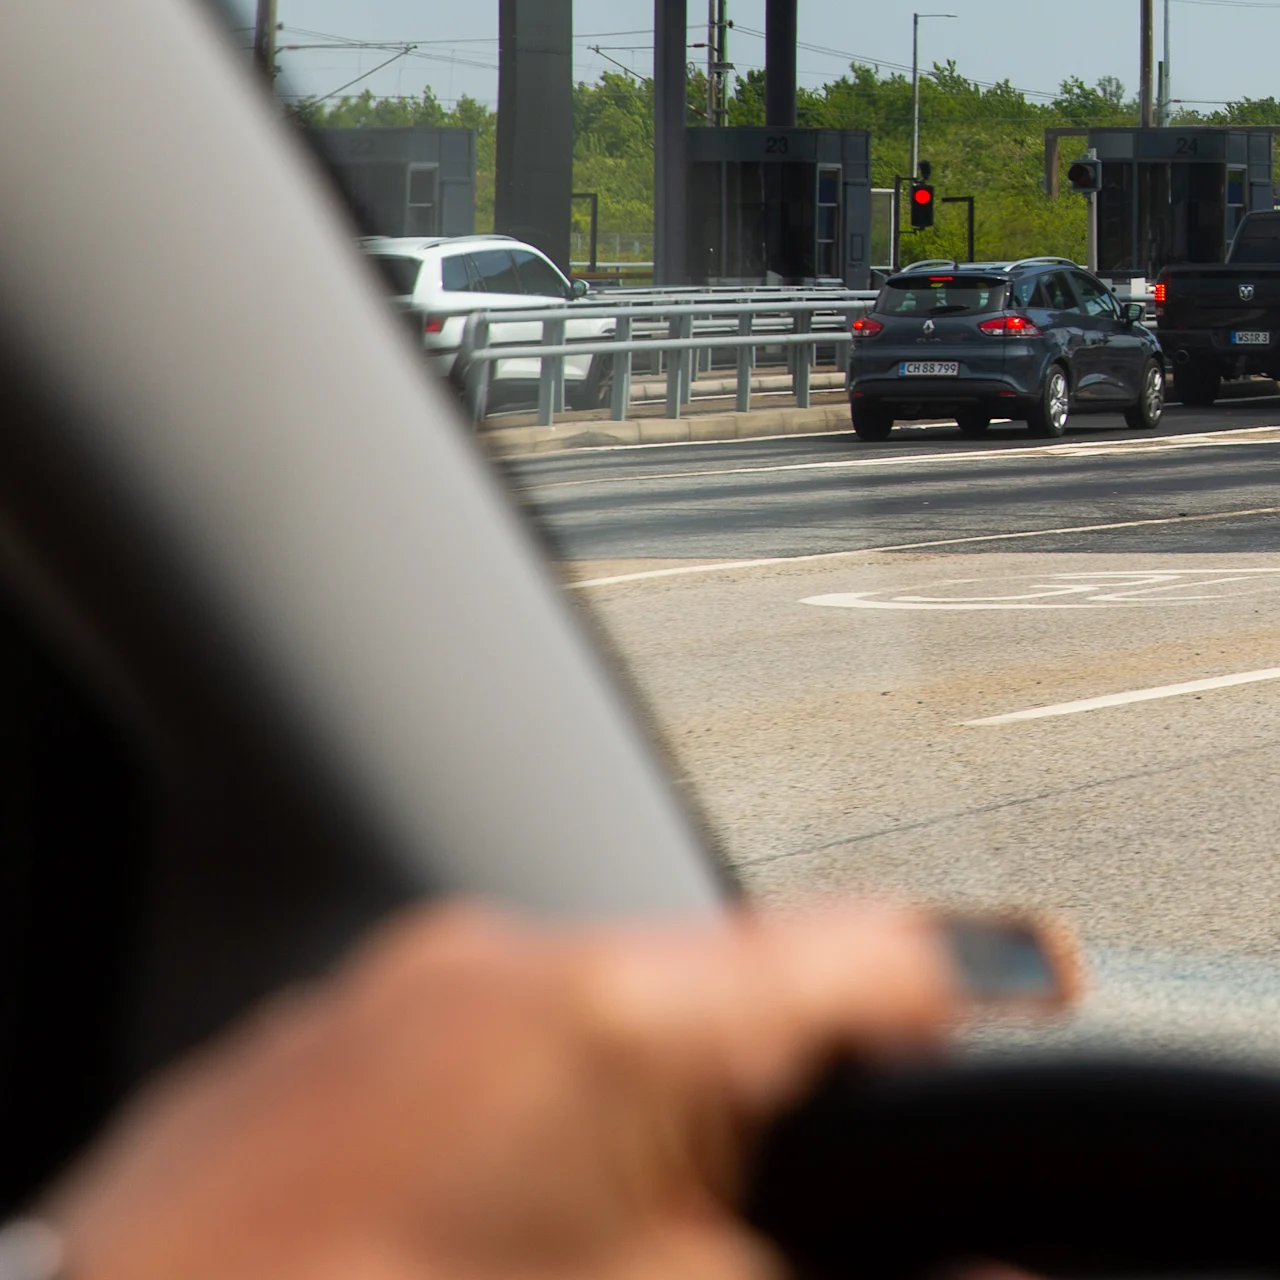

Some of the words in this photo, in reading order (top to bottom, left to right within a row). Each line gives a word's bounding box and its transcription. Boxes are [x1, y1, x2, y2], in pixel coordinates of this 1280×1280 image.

[766, 136, 788, 155] 23
[1176, 137, 1198, 155] 24
[906, 363, 920, 373] CH
[922, 363, 935, 373] 88
[937, 363, 957, 373] 799
